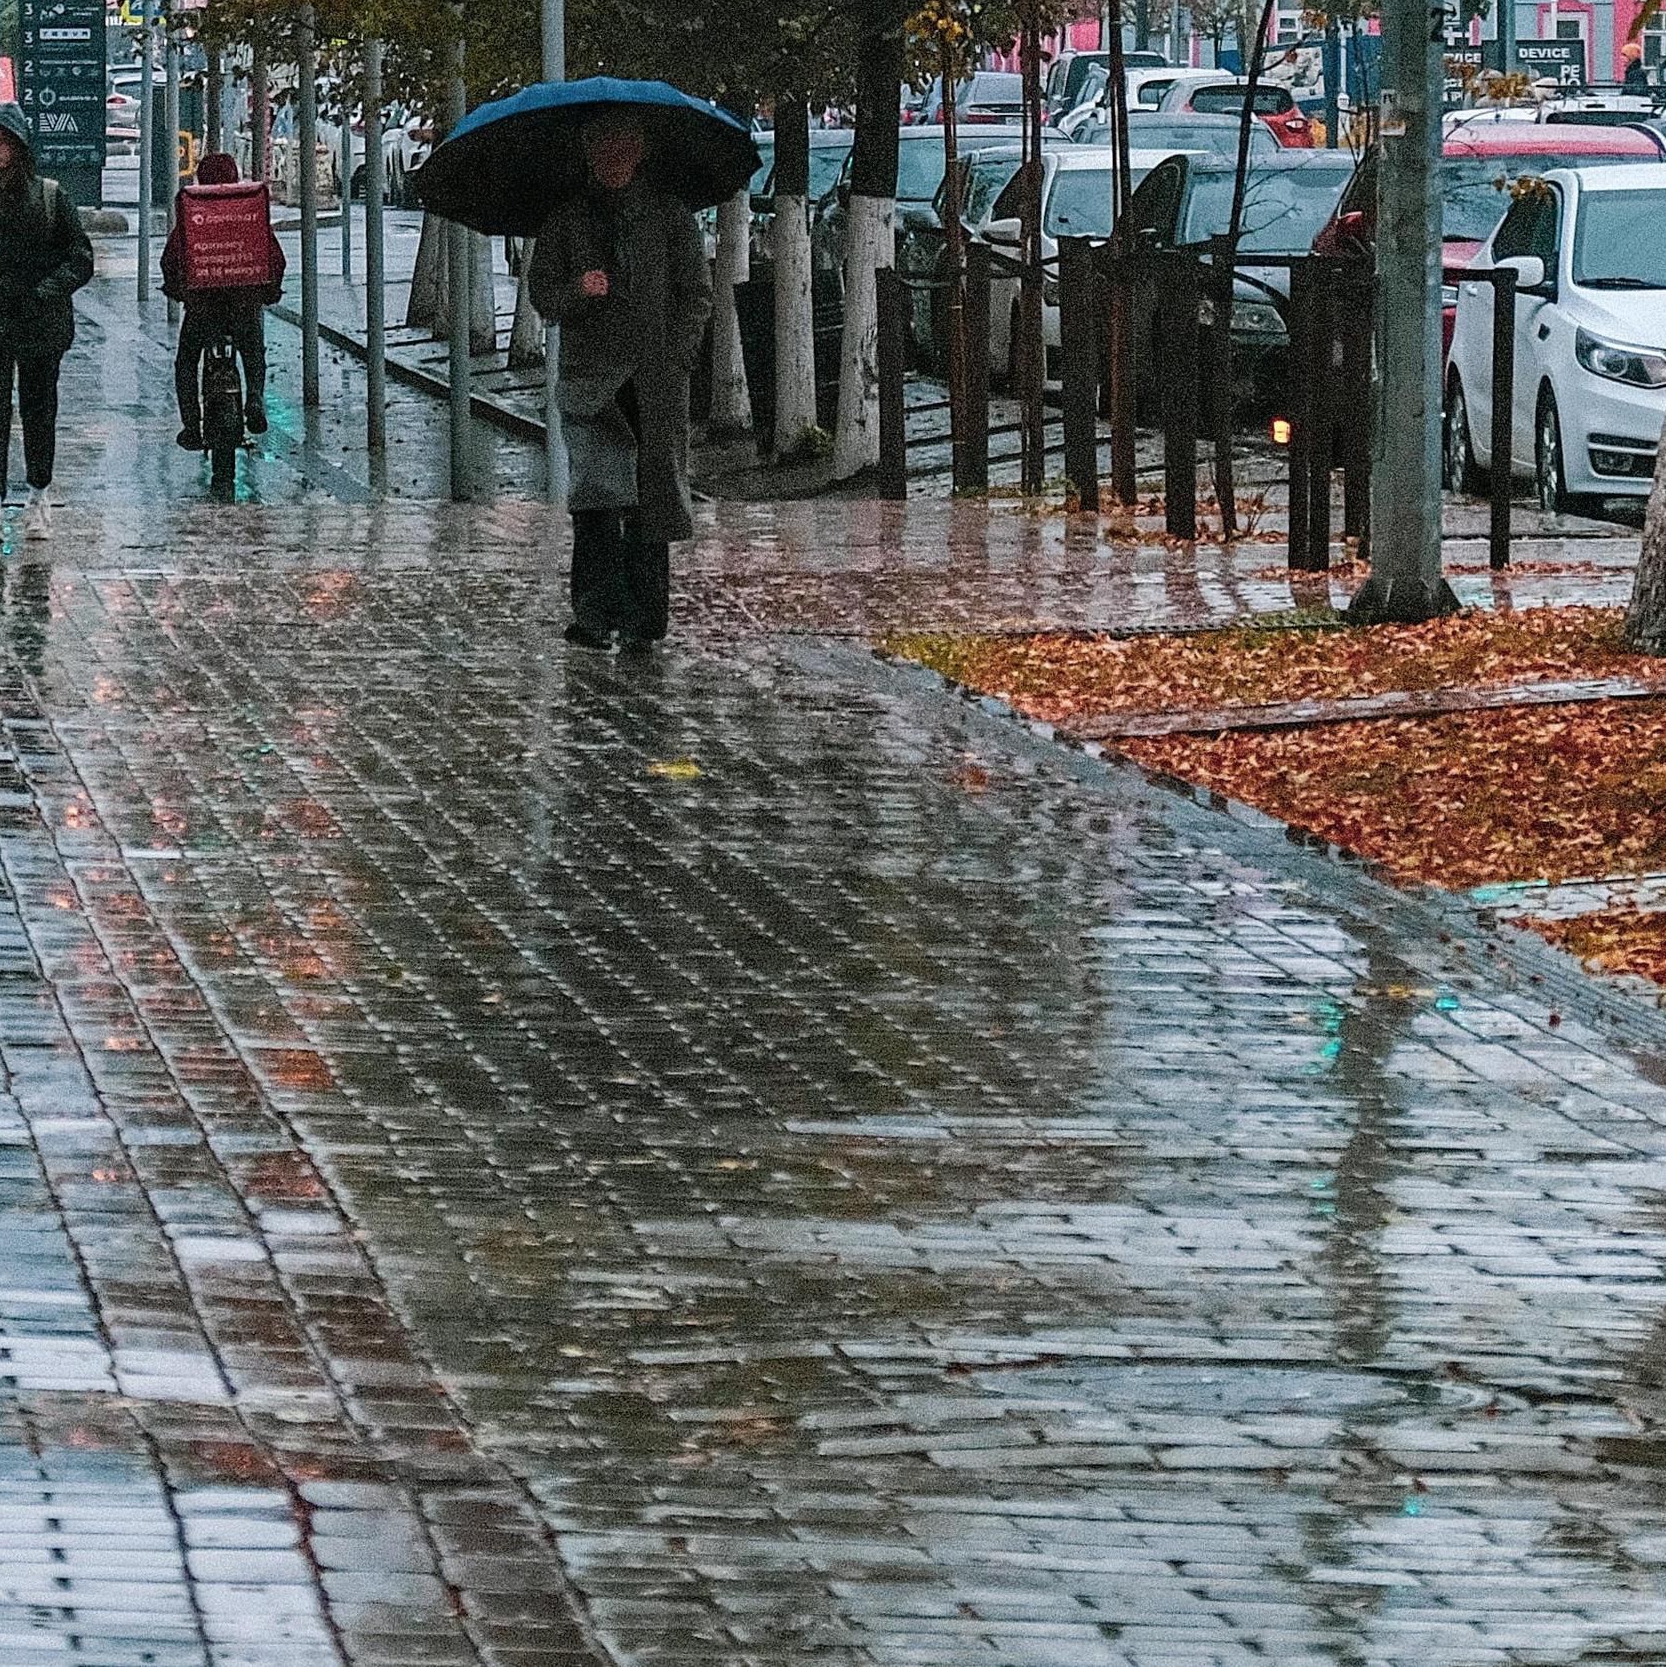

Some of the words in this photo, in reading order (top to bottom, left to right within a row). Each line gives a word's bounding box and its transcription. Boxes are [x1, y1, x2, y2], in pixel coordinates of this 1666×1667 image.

[24, 3, 33, 15] 3
[24, 31, 33, 44] 3
[1519, 48, 1570, 59] DEVICE
[24, 61, 33, 72] 2
[24, 89, 33, 101] 2
